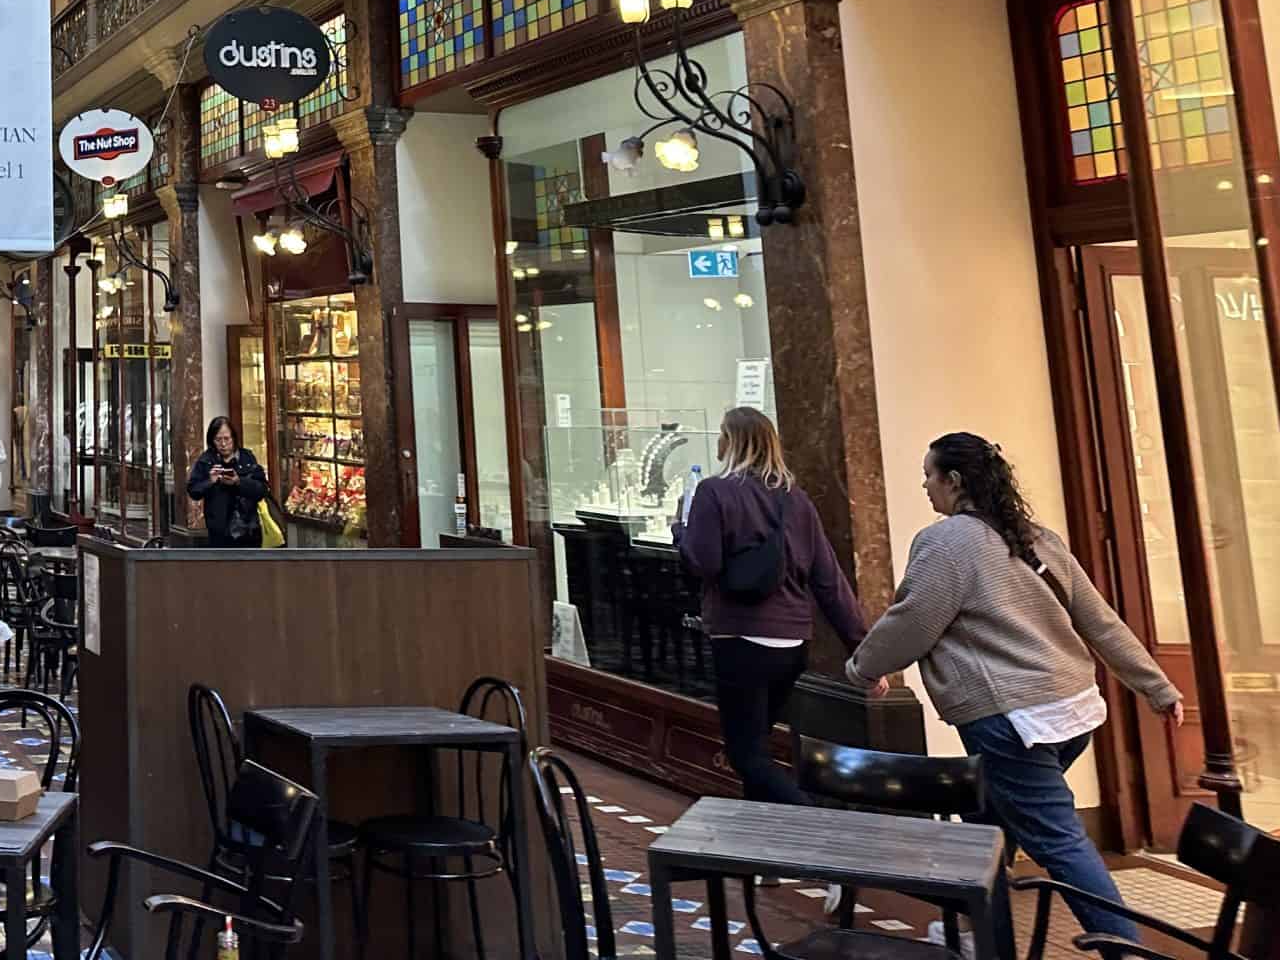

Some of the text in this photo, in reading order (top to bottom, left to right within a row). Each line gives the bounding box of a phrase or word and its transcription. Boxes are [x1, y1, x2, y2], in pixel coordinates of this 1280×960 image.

[219, 39, 318, 69] dustins
[263, 98, 276, 109] 23
[78, 134, 136, 153] The Nut Shop
[18, 163, 24, 179] 1
